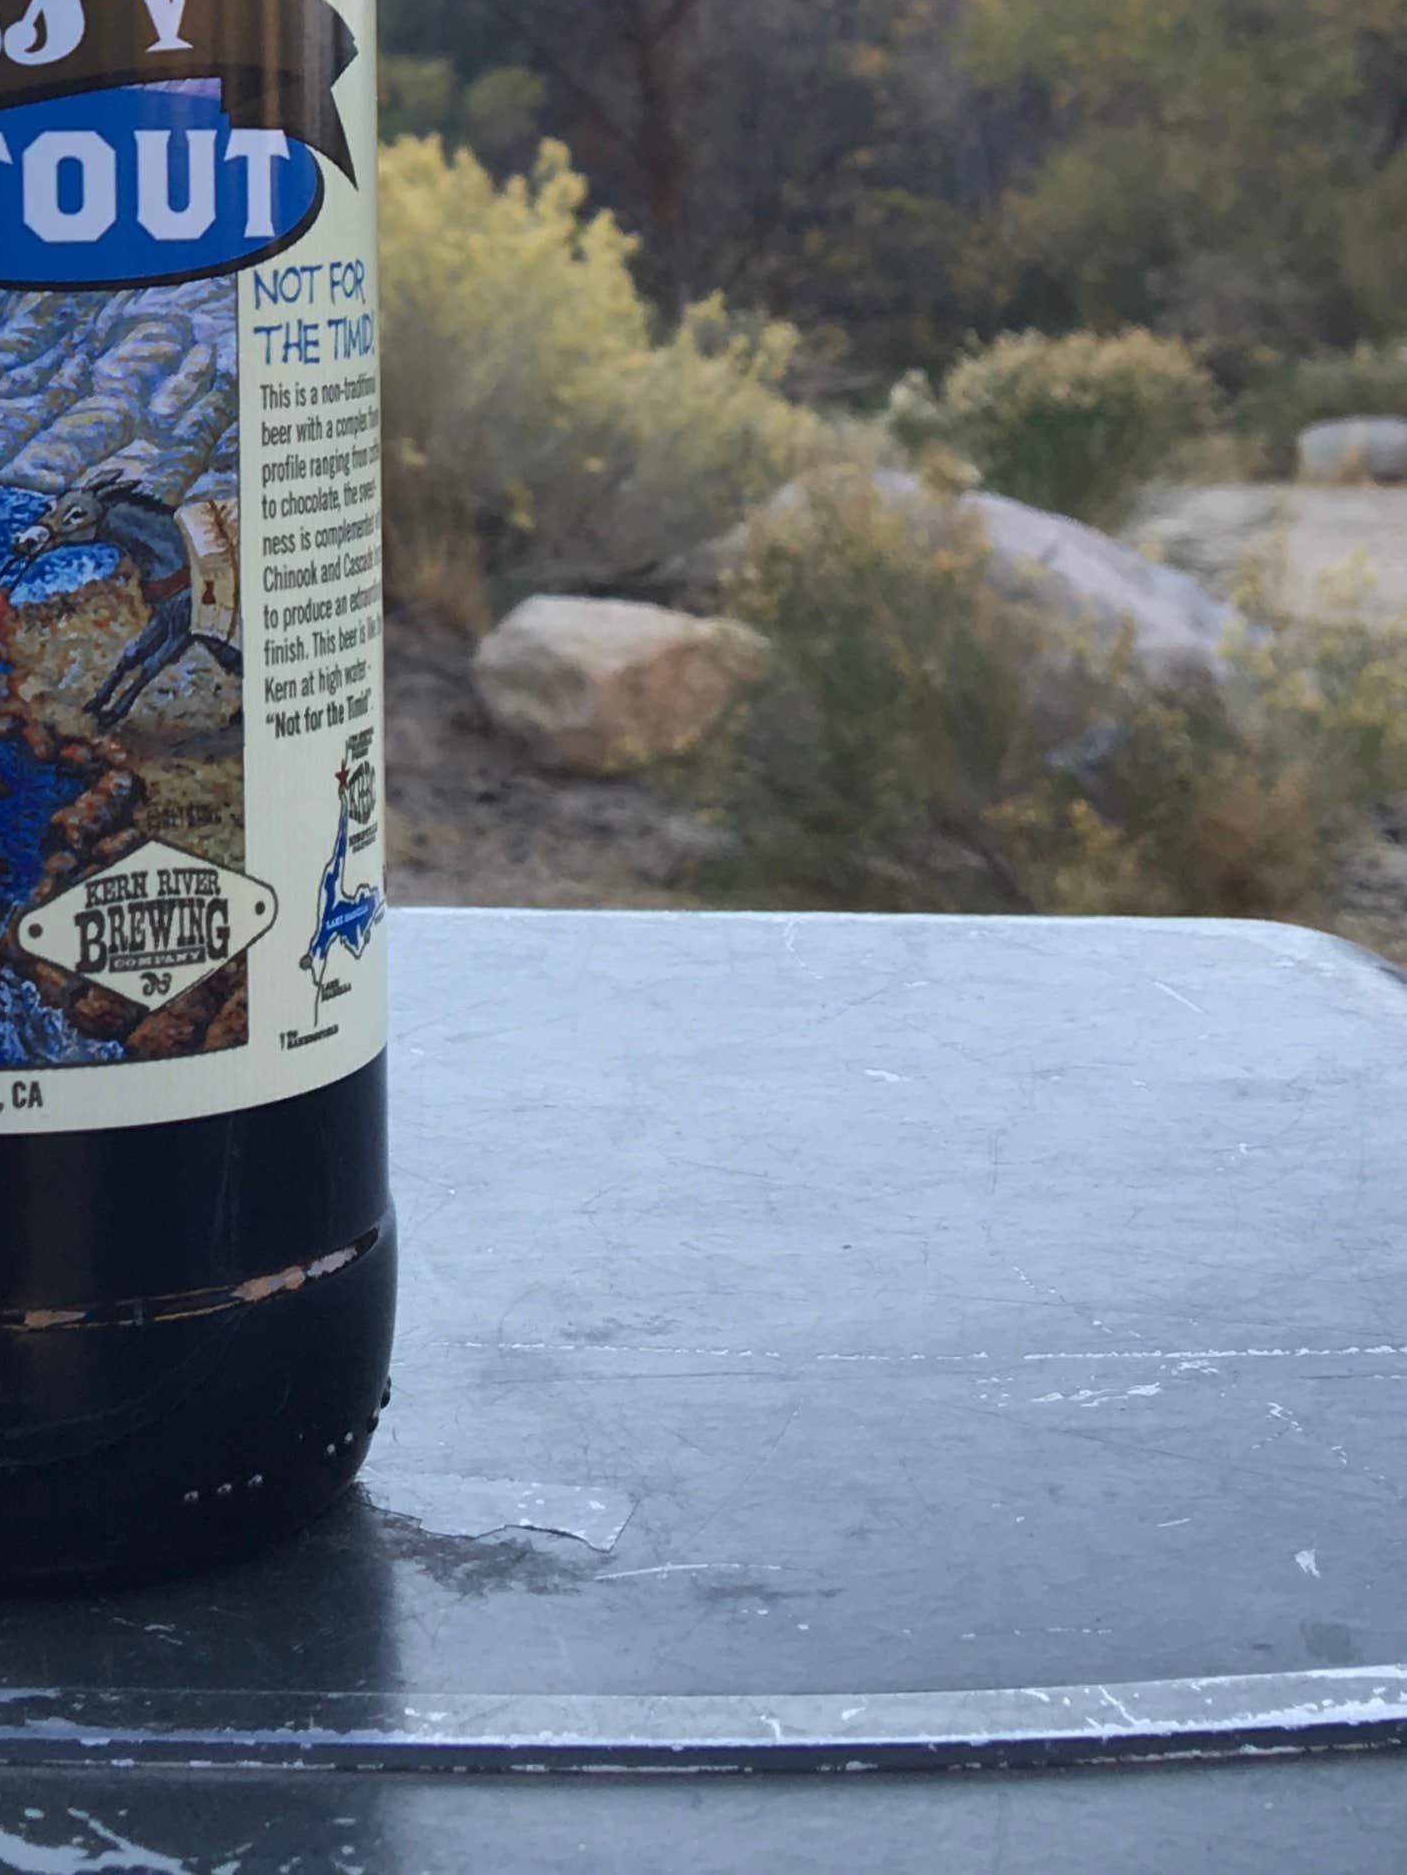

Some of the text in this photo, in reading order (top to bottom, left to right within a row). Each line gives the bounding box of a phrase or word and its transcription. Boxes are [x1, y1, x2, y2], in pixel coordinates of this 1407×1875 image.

[253, 259, 366, 309] NOT FOR
[253, 319, 321, 365] THE
[260, 382, 291, 410] This
[295, 380, 307, 407] is
[310, 384, 318, 404] a
[261, 421, 291, 447] beer
[297, 414, 323, 442] with
[326, 420, 334, 440] a
[261, 454, 306, 487] profile
[310, 448, 350, 480] ranging
[262, 493, 277, 519] to
[281, 485, 341, 516] chocolate,
[262, 531, 296, 557] ness
[300, 526, 311, 551] is
[262, 560, 317, 593] Chinook
[321, 554, 341, 584] and
[263, 596, 347, 632] to produce an
[263, 633, 309, 667] finish.
[312, 630, 336, 658] This
[339, 624, 358, 653] beer
[264, 677, 297, 704] Kern
[301, 672, 315, 696] at
[319, 665, 342, 695] high
[304, 705, 323, 732] for
[327, 700, 345, 726] the
[85, 868, 221, 909] KERN RIVER
[74, 898, 230, 974] BREWING
[112, 948, 204, 971] COMPANY
[12, 1080, 43, 1108] CA
